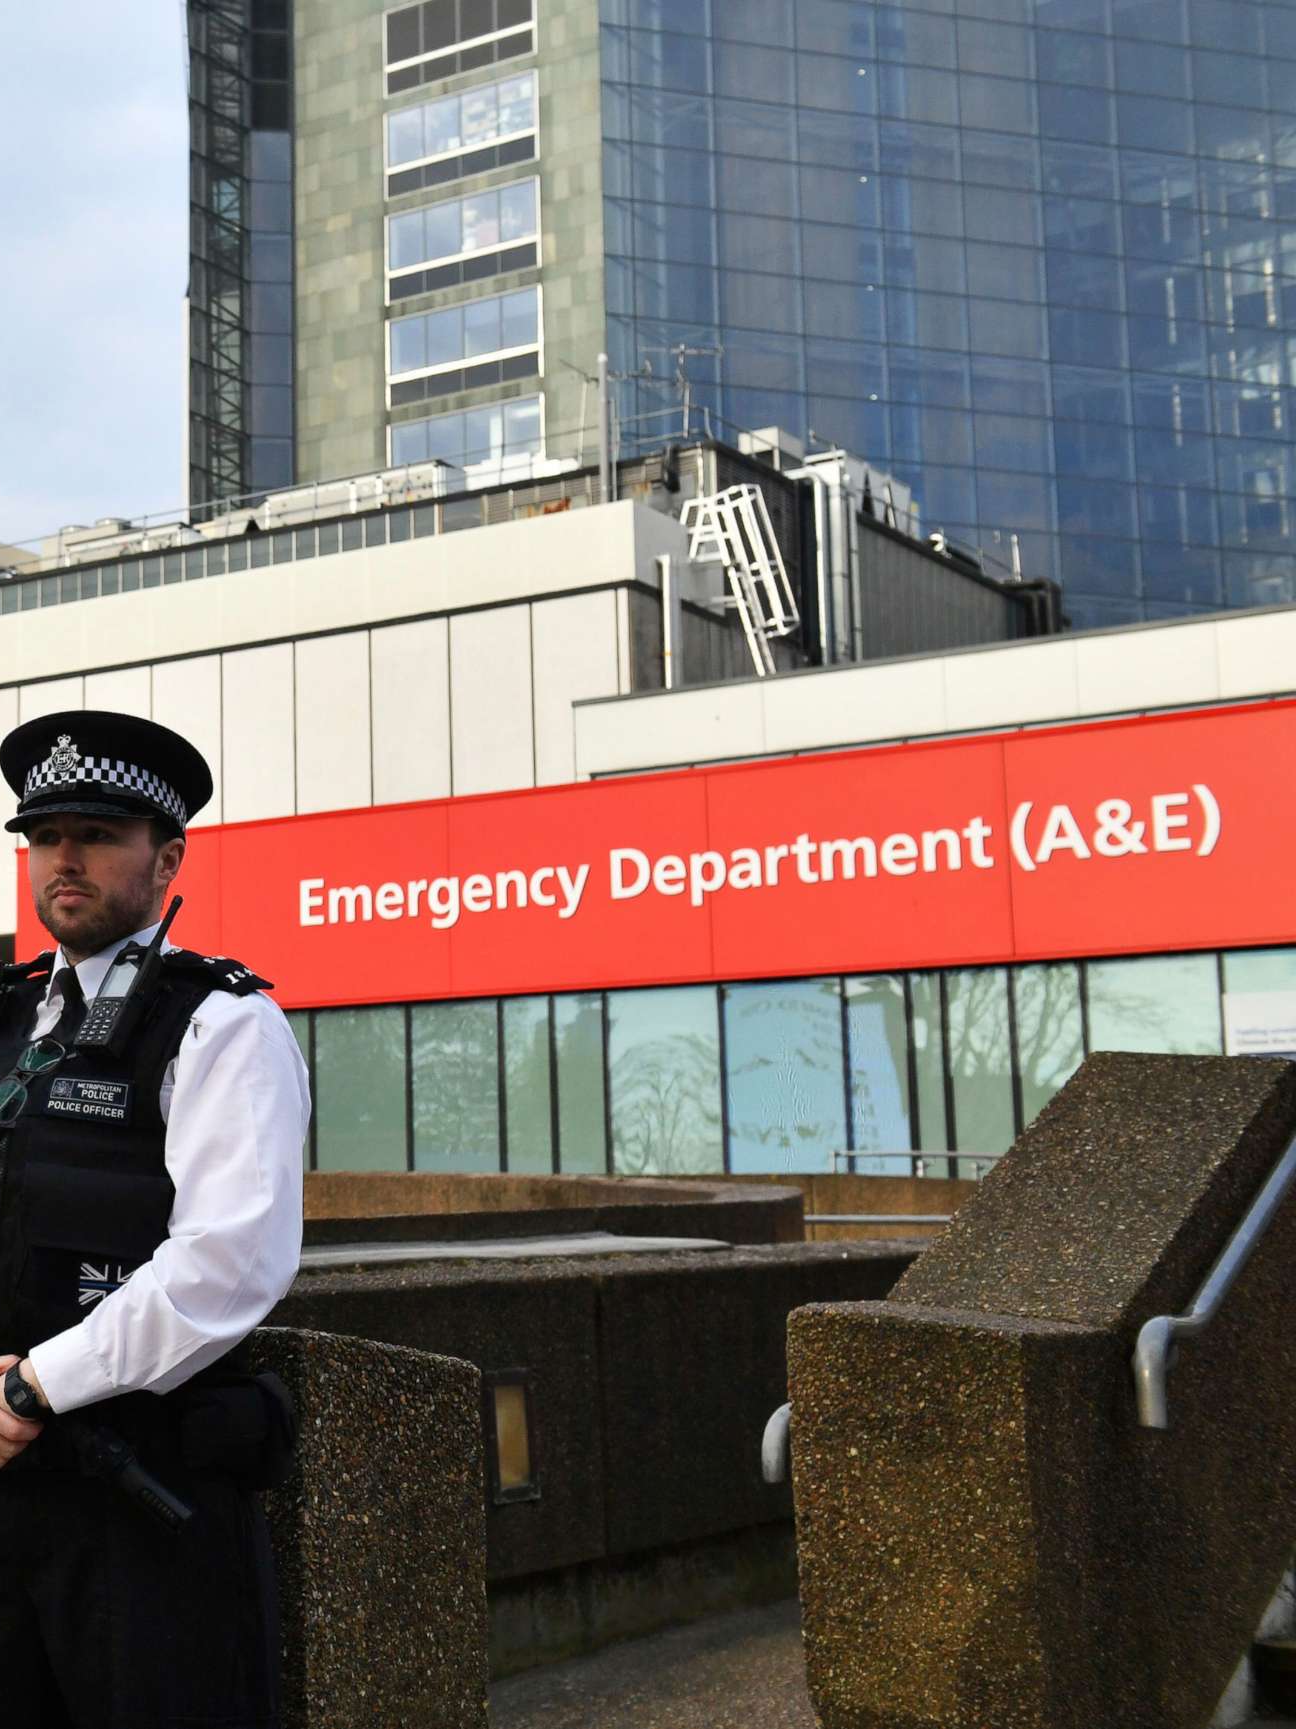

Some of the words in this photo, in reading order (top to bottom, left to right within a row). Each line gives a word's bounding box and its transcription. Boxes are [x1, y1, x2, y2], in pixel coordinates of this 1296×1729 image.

[298, 863, 591, 930] Emergency
[608, 816, 994, 907] Department
[1009, 783, 1221, 872] (A&E)
[76, 1082, 122, 1094] METROPOLITAN
[81, 1089, 115, 1102] POLICE
[47, 1100, 82, 1113] POLICE
[82, 1104, 125, 1119] OFFICER
